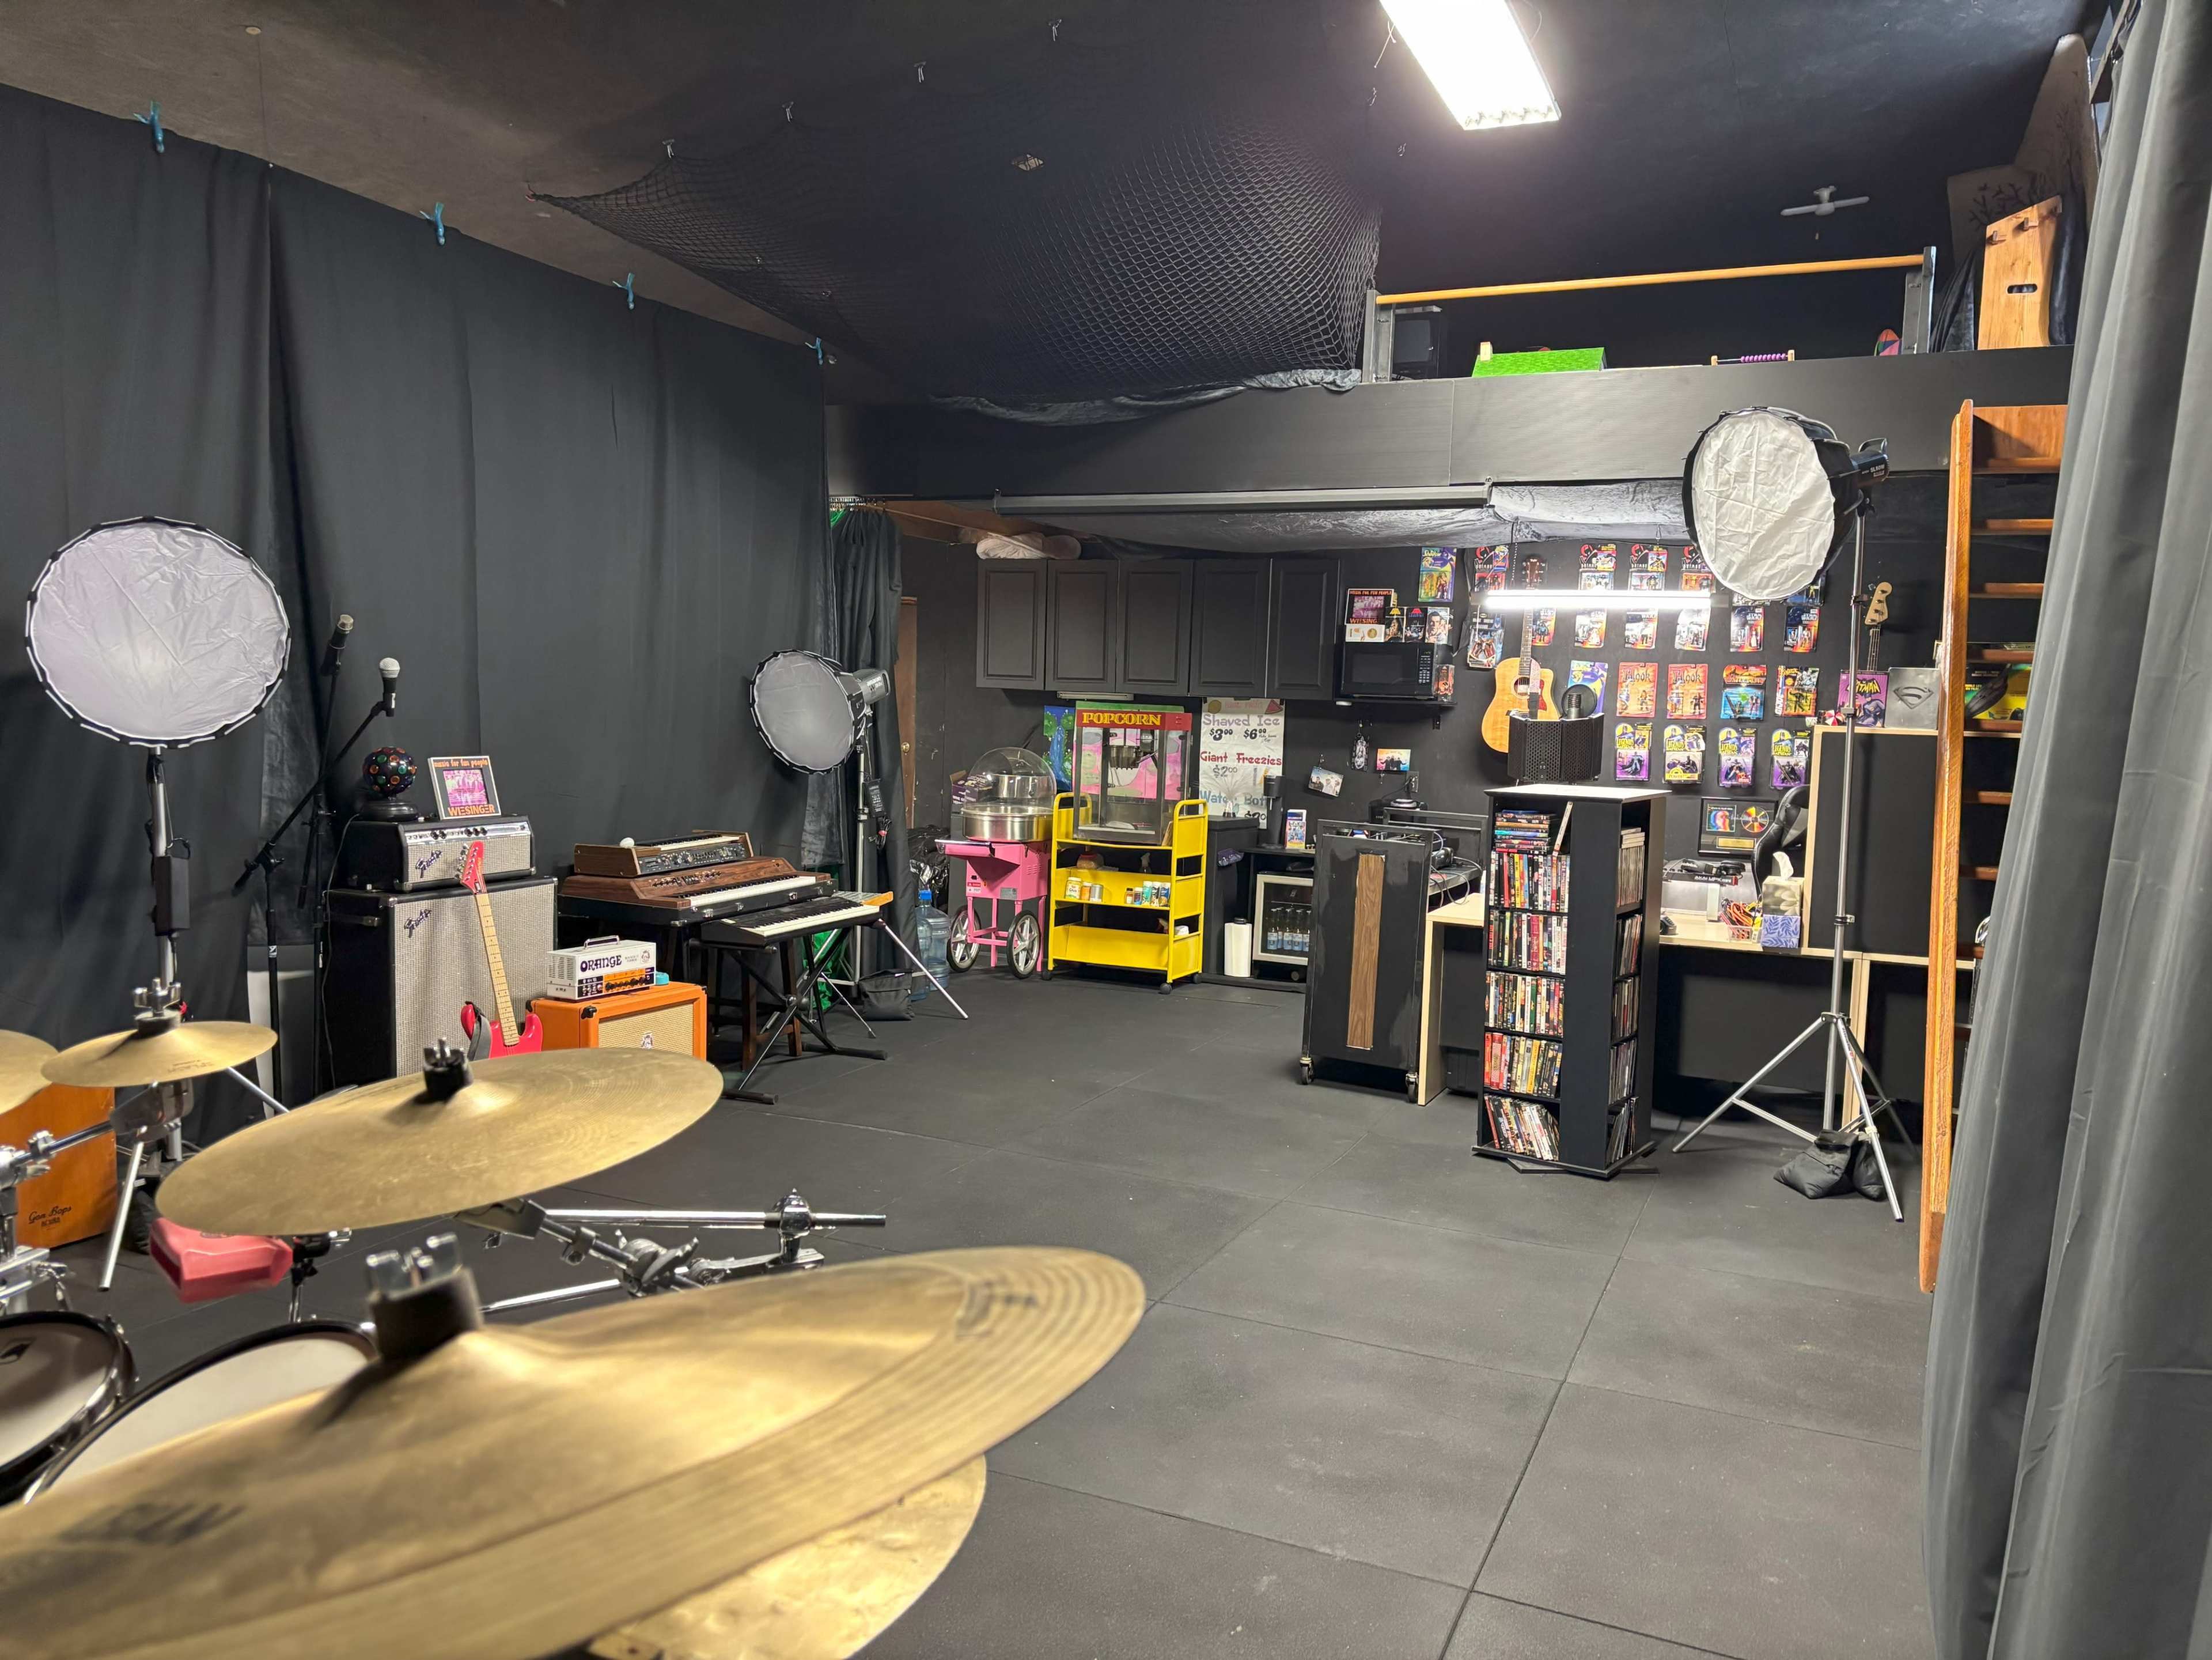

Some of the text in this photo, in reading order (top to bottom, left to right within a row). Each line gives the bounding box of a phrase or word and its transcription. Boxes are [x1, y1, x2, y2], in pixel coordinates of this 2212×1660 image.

[1623, 668, 1651, 683] Hook
[1673, 670, 1703, 685] Hook
[1082, 712, 1161, 726] POPCORN
[1203, 714, 1280, 727] Shaved Ice
[1200, 751, 1282, 766] Giant Freezies
[448, 804, 495, 816] WIESINGER
[581, 955, 622, 973] ORANGE
